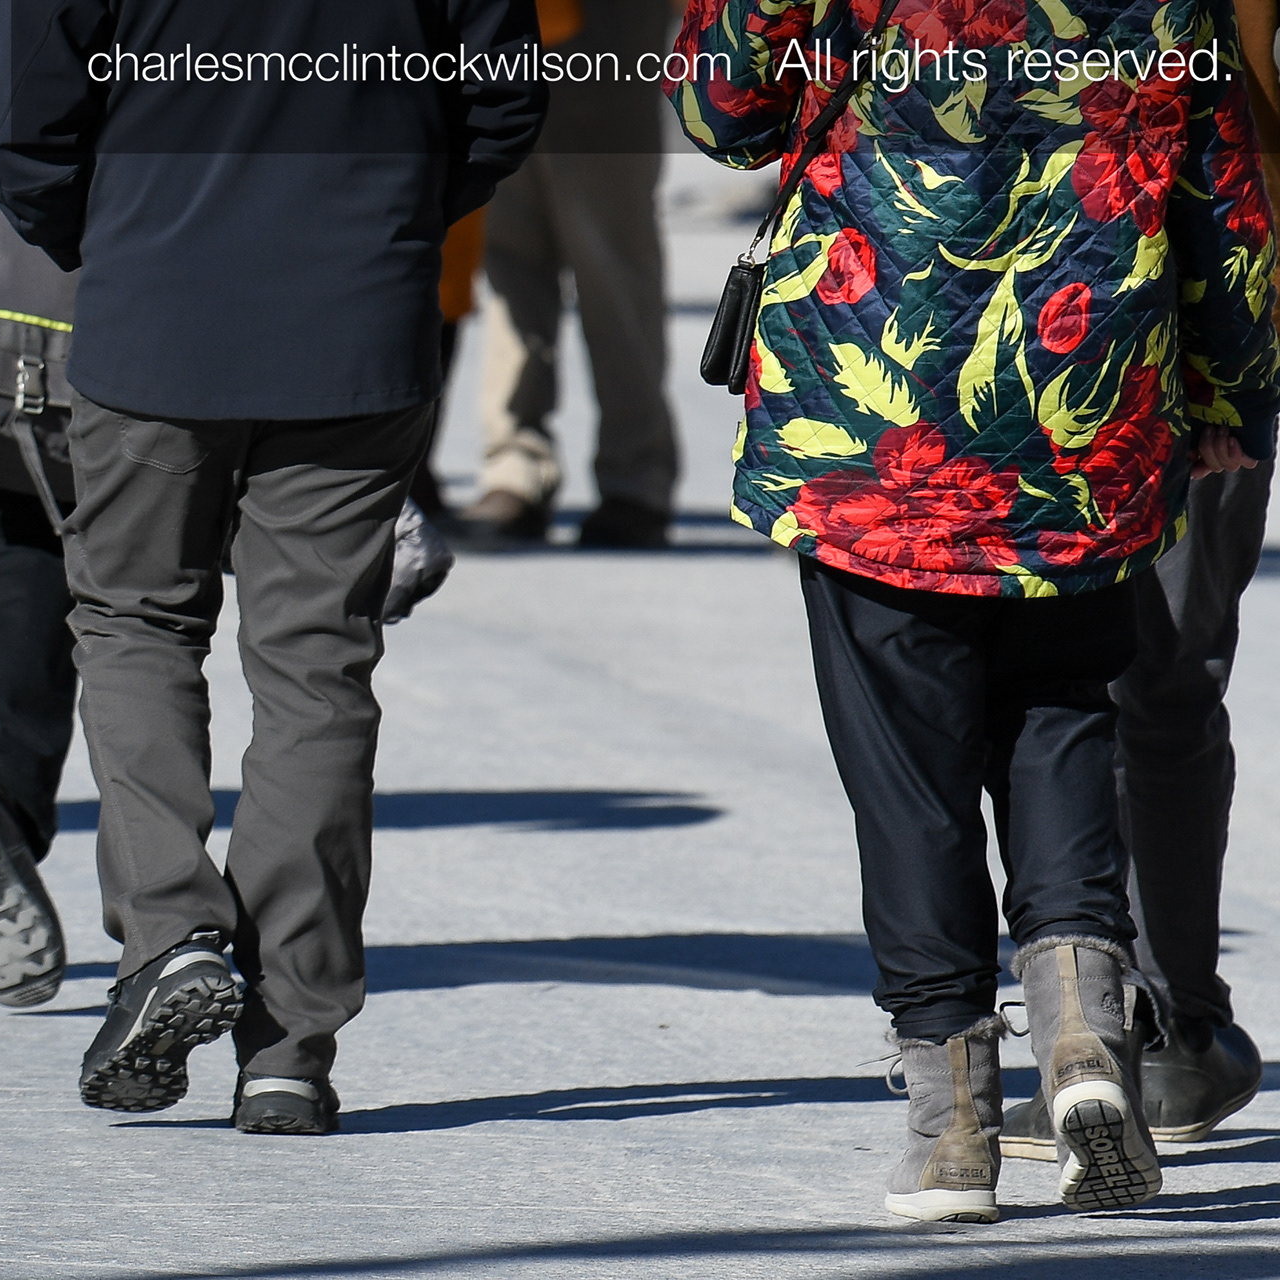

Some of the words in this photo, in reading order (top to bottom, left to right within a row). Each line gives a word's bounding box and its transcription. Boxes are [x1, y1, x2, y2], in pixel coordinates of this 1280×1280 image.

[1056, 1059, 1105, 1079] SOREL
[1084, 1125, 1132, 1189] SOREL
[939, 1166, 988, 1180] SOREL
